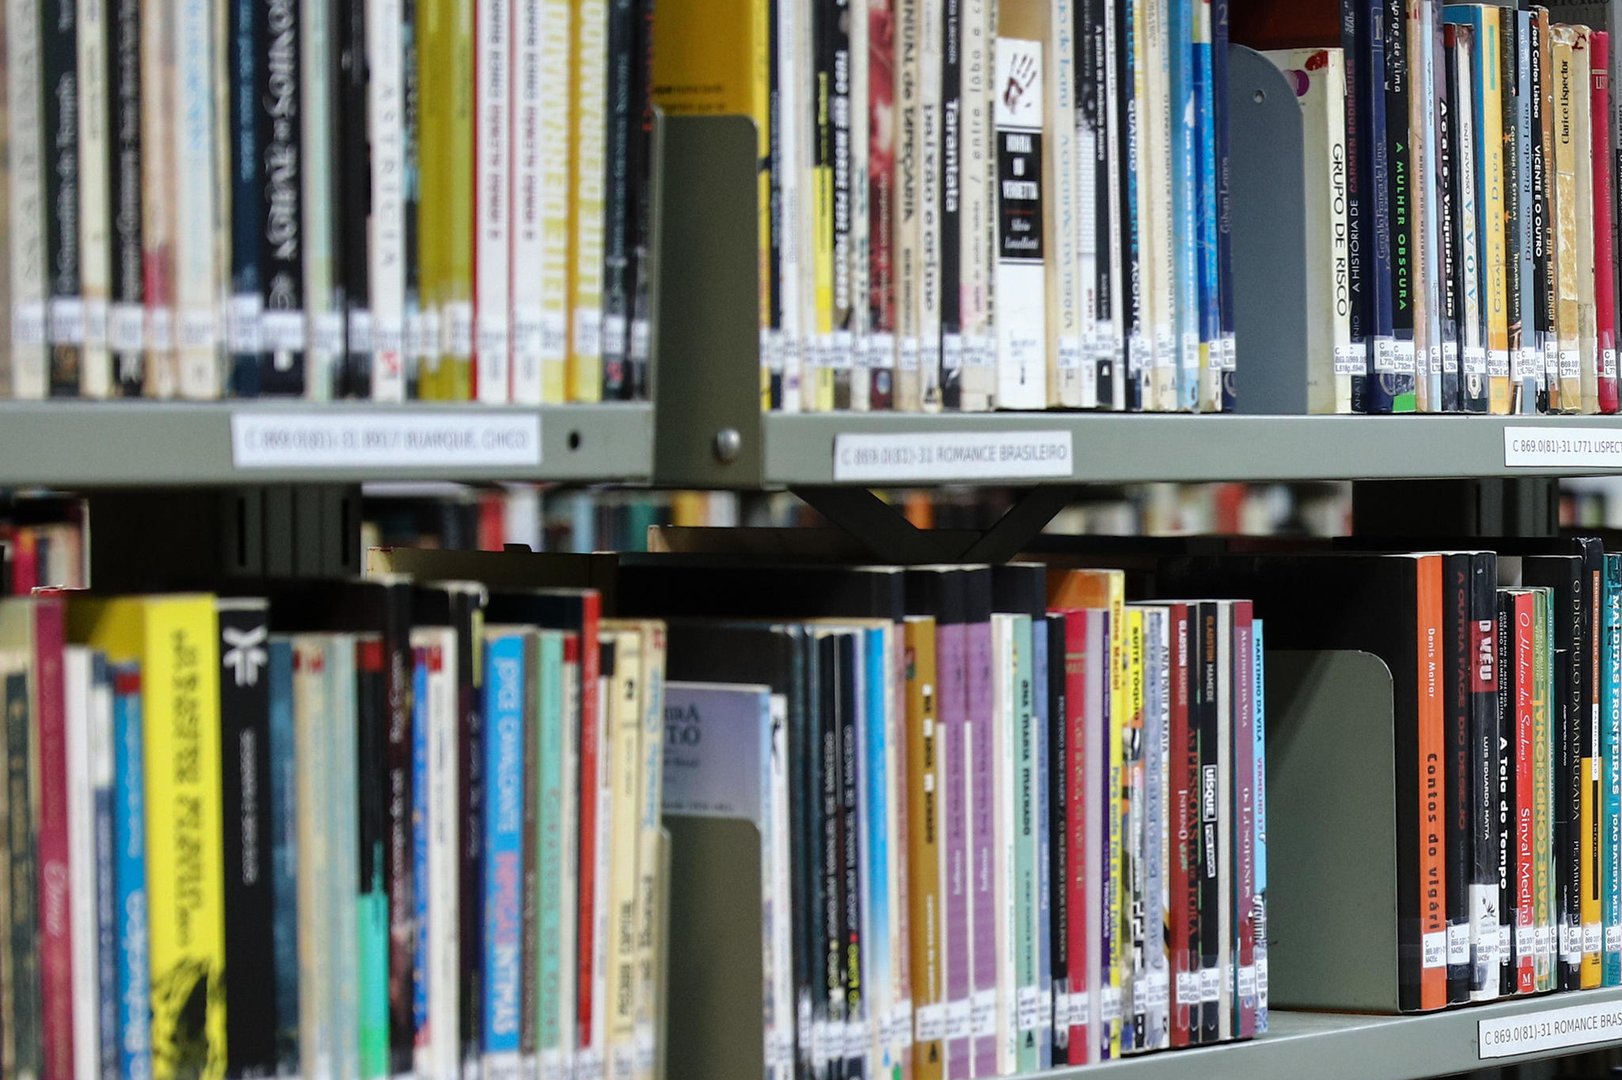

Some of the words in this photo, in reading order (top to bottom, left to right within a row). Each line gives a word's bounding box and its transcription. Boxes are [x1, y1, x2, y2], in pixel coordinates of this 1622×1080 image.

[1532, 25, 1540, 46] José
[1559, 60, 1569, 107] Lispector
[1396, 142, 1404, 152] A
[1560, 108, 1569, 144] Clarice
[945, 101, 957, 212] Tarantata
[1333, 143, 1345, 214] GRUPO
[1397, 160, 1405, 225] MULHER
[1349, 200, 1358, 216] DE
[1335, 223, 1346, 248] DE
[1350, 220, 1359, 278] HISTÓRIA
[1337, 257, 1349, 317] RISCO
[1352, 282, 1360, 292] A
[1398, 235, 1408, 310] OBSCURA
[1513, 440, 1519, 452] C
[1521, 440, 1571, 453] 869.0(81)-31
[1574, 441, 1591, 453] L771
[1573, 580, 1581, 593] O
[1206, 616, 1214, 662] GLADSTON
[1520, 613, 1529, 628] O
[1612, 595, 1621, 682] MALDITAS
[1518, 634, 1530, 685] Herdeiro
[1573, 599, 1582, 685] DISCÍPULO
[1206, 664, 1214, 702] MAMEDE
[1428, 662, 1436, 698] Mattar
[1519, 688, 1528, 706] das
[1573, 690, 1581, 712] DA
[1256, 700, 1262, 714] DA
[1500, 737, 1507, 750] A
[1519, 710, 1530, 761] Sombras
[1612, 688, 1621, 794] FRONTEIRAS
[1427, 754, 1438, 822] Contos
[1499, 756, 1508, 794] Teia
[1572, 719, 1581, 821] MADRUGADA
[1499, 801, 1507, 822] do
[1520, 808, 1532, 857] Sinval
[1611, 814, 1620, 842] JOÃO
[1428, 834, 1439, 856] do
[1498, 828, 1508, 890] Tempo
[1611, 845, 1619, 893] BATISTA
[1428, 866, 1441, 929] vigári
[1520, 861, 1532, 926] Medina
[1485, 1032, 1491, 1045] C
[1495, 1023, 1550, 1044] 869.0(81)-31
[1555, 1016, 1597, 1035] ROMANCE
